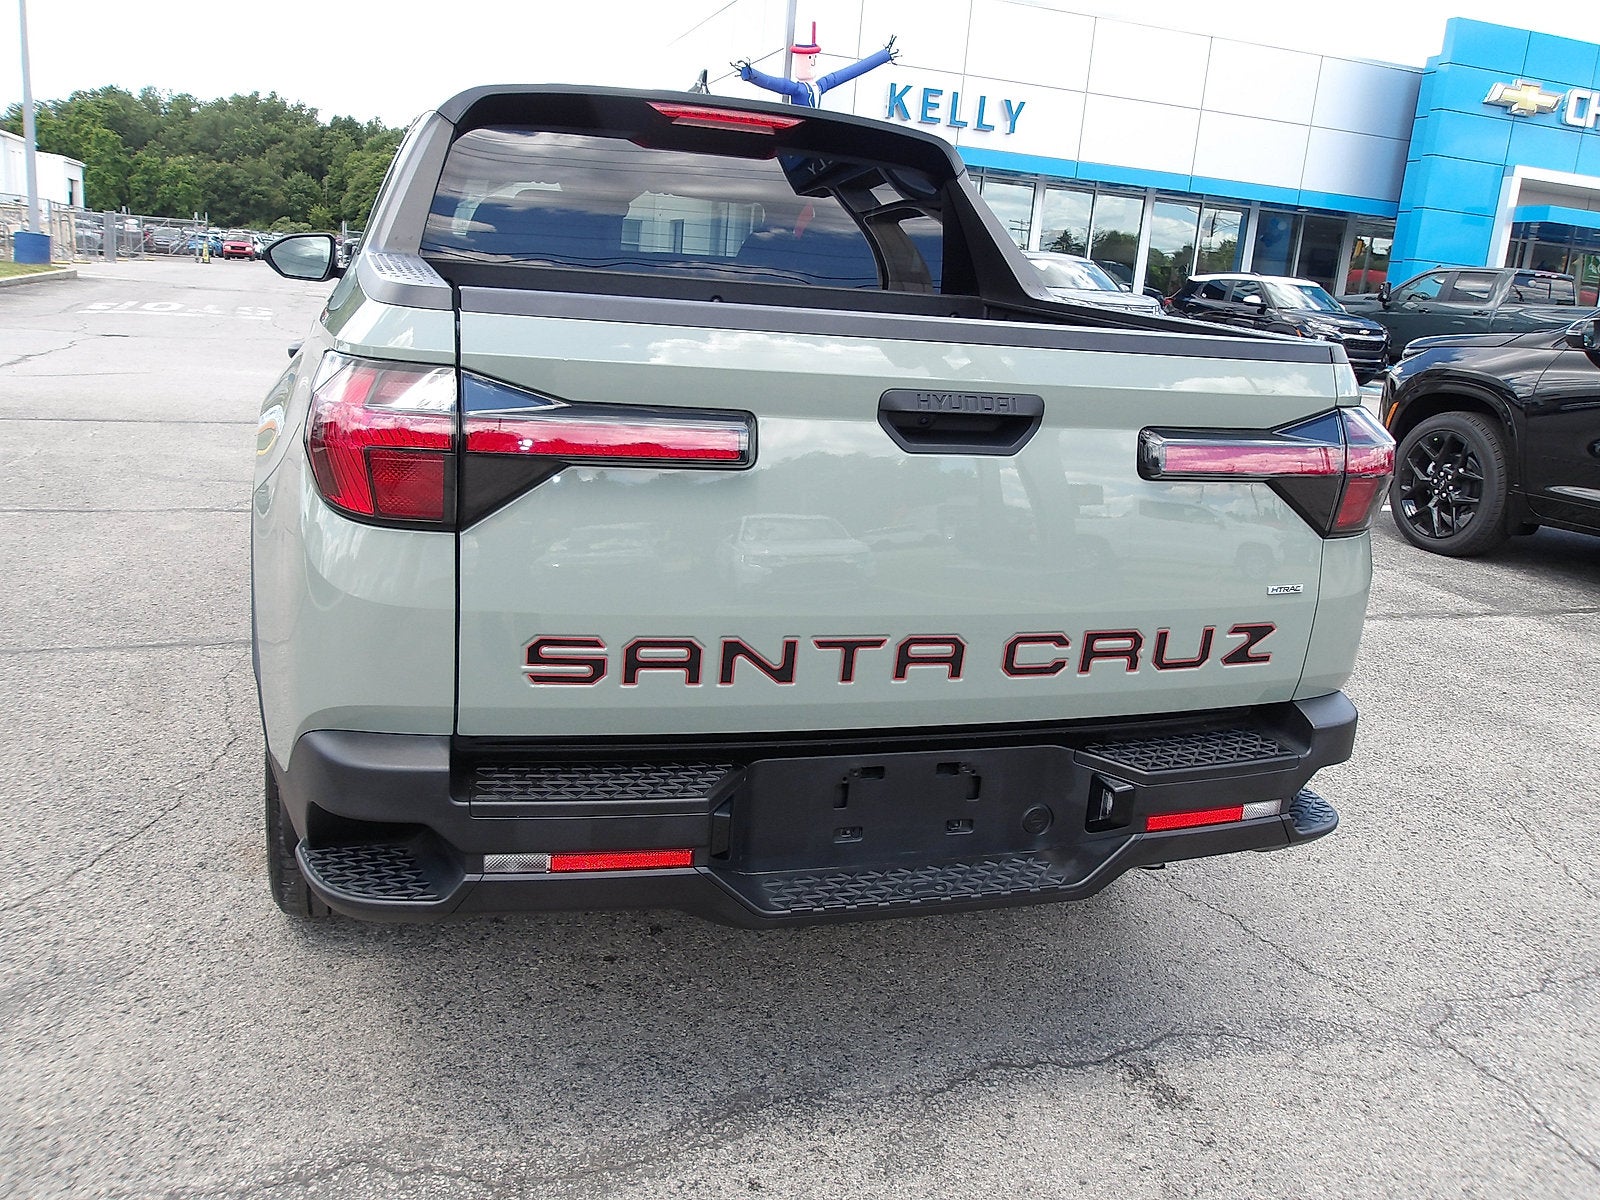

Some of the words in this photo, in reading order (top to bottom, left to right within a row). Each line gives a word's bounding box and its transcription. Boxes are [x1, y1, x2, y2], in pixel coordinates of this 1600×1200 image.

[885, 82, 1026, 134] KELLY
[80, 301, 273, 318] STOP
[916, 393, 1018, 413] HYUNDAI
[1270, 585, 1301, 593] HTRAC
[522, 634, 967, 687] SANTA
[1000, 622, 1277, 680] CRUZ
